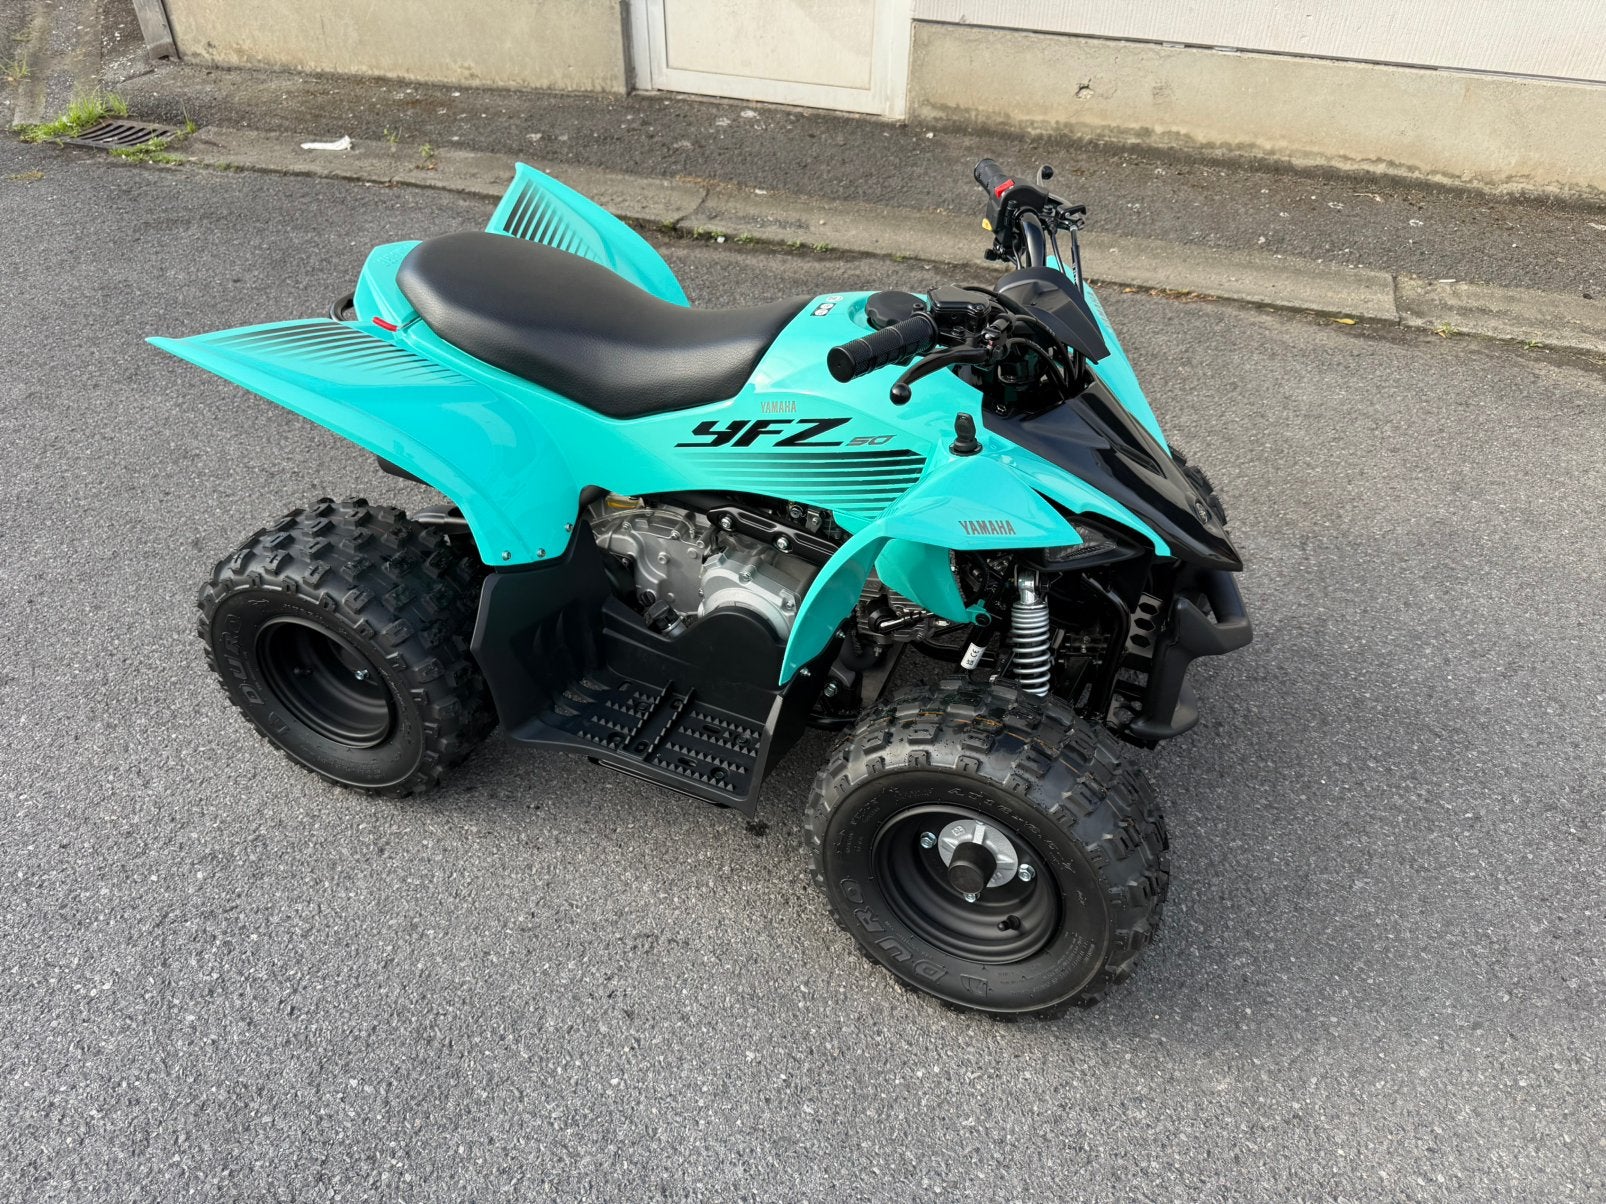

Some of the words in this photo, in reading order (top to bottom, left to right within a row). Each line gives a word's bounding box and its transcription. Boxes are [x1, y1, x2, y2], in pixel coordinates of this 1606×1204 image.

[760, 400, 797, 414] YAMAHA
[674, 417, 853, 448] YFZ
[844, 434, 897, 447] 50
[958, 520, 1016, 536] YAMAHA
[840, 878, 949, 982] DURO
